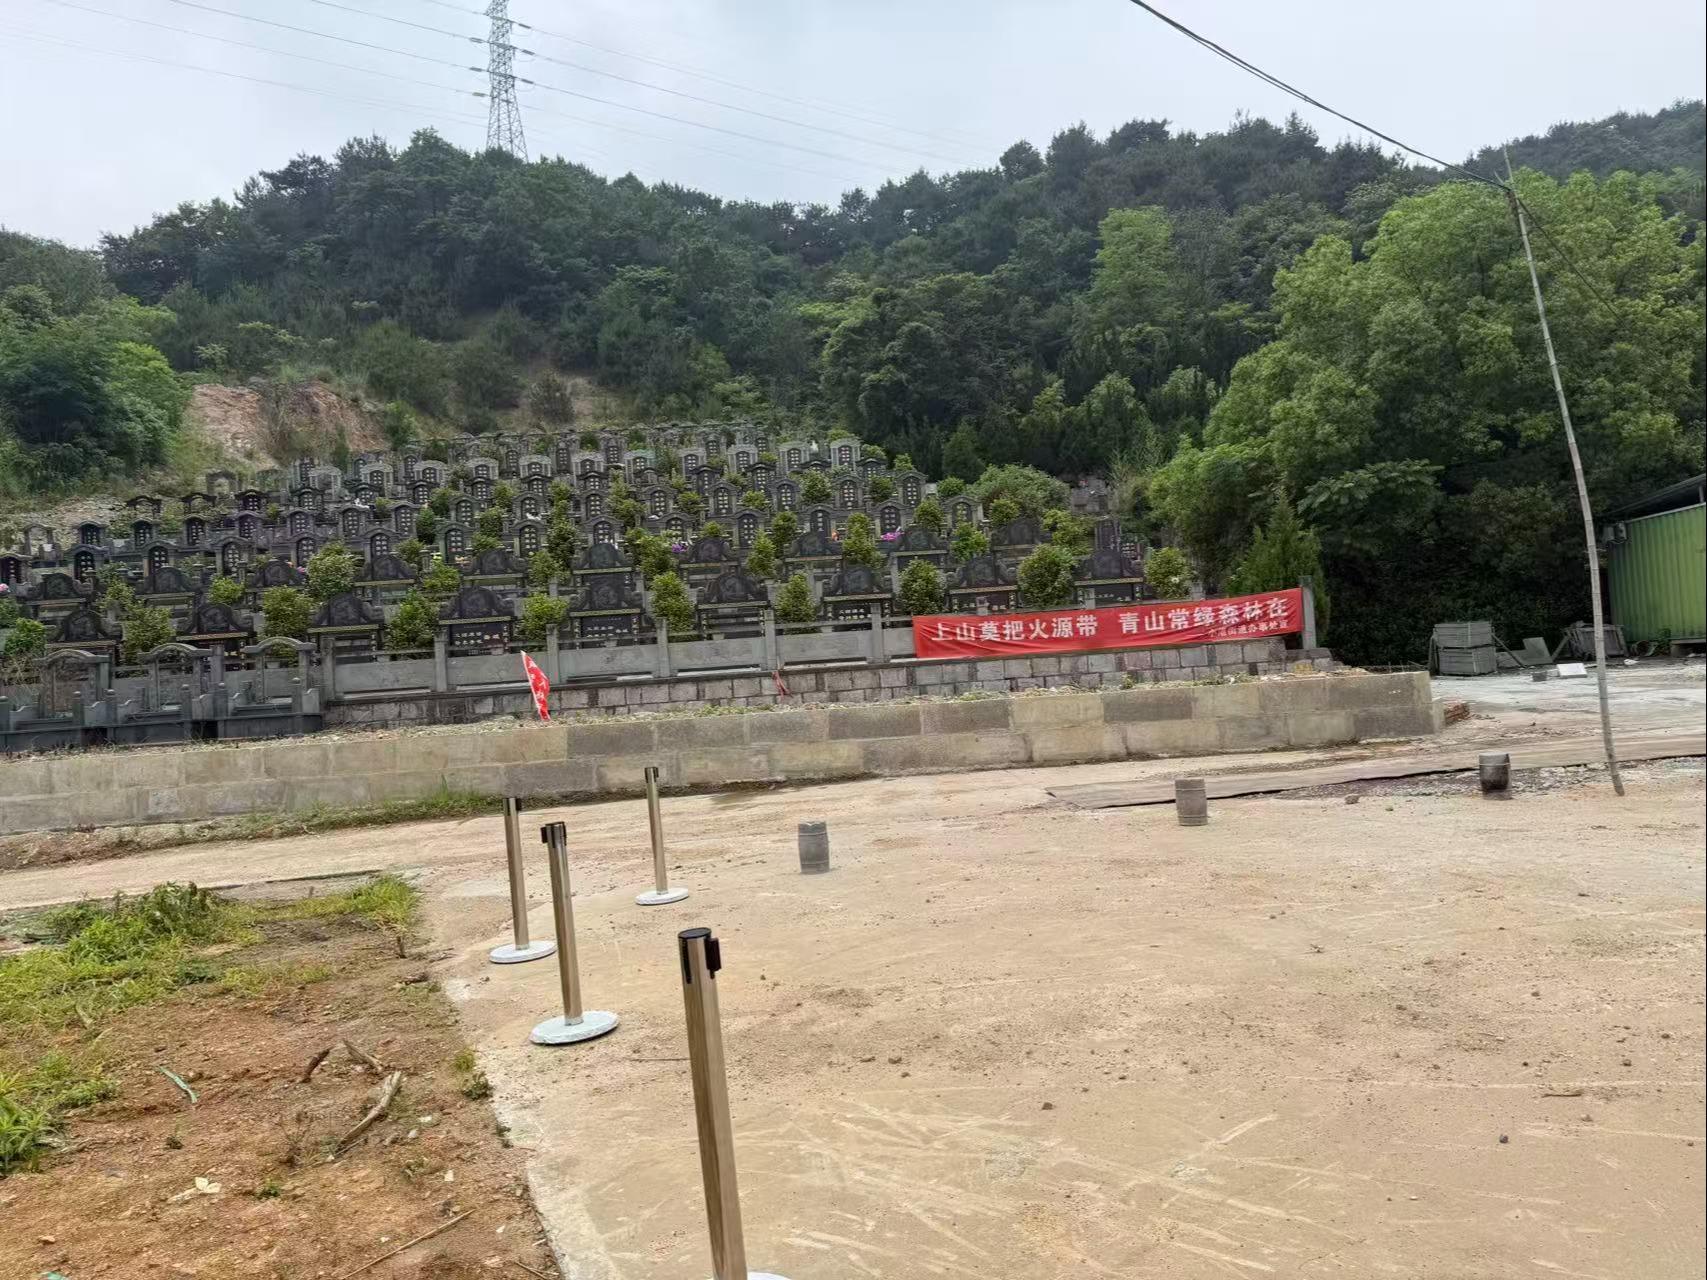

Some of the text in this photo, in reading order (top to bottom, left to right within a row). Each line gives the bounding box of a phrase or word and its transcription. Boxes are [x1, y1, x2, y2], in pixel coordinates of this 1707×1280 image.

[931, 597, 1289, 641] 上山莫把火源带 青山常绿森林在
